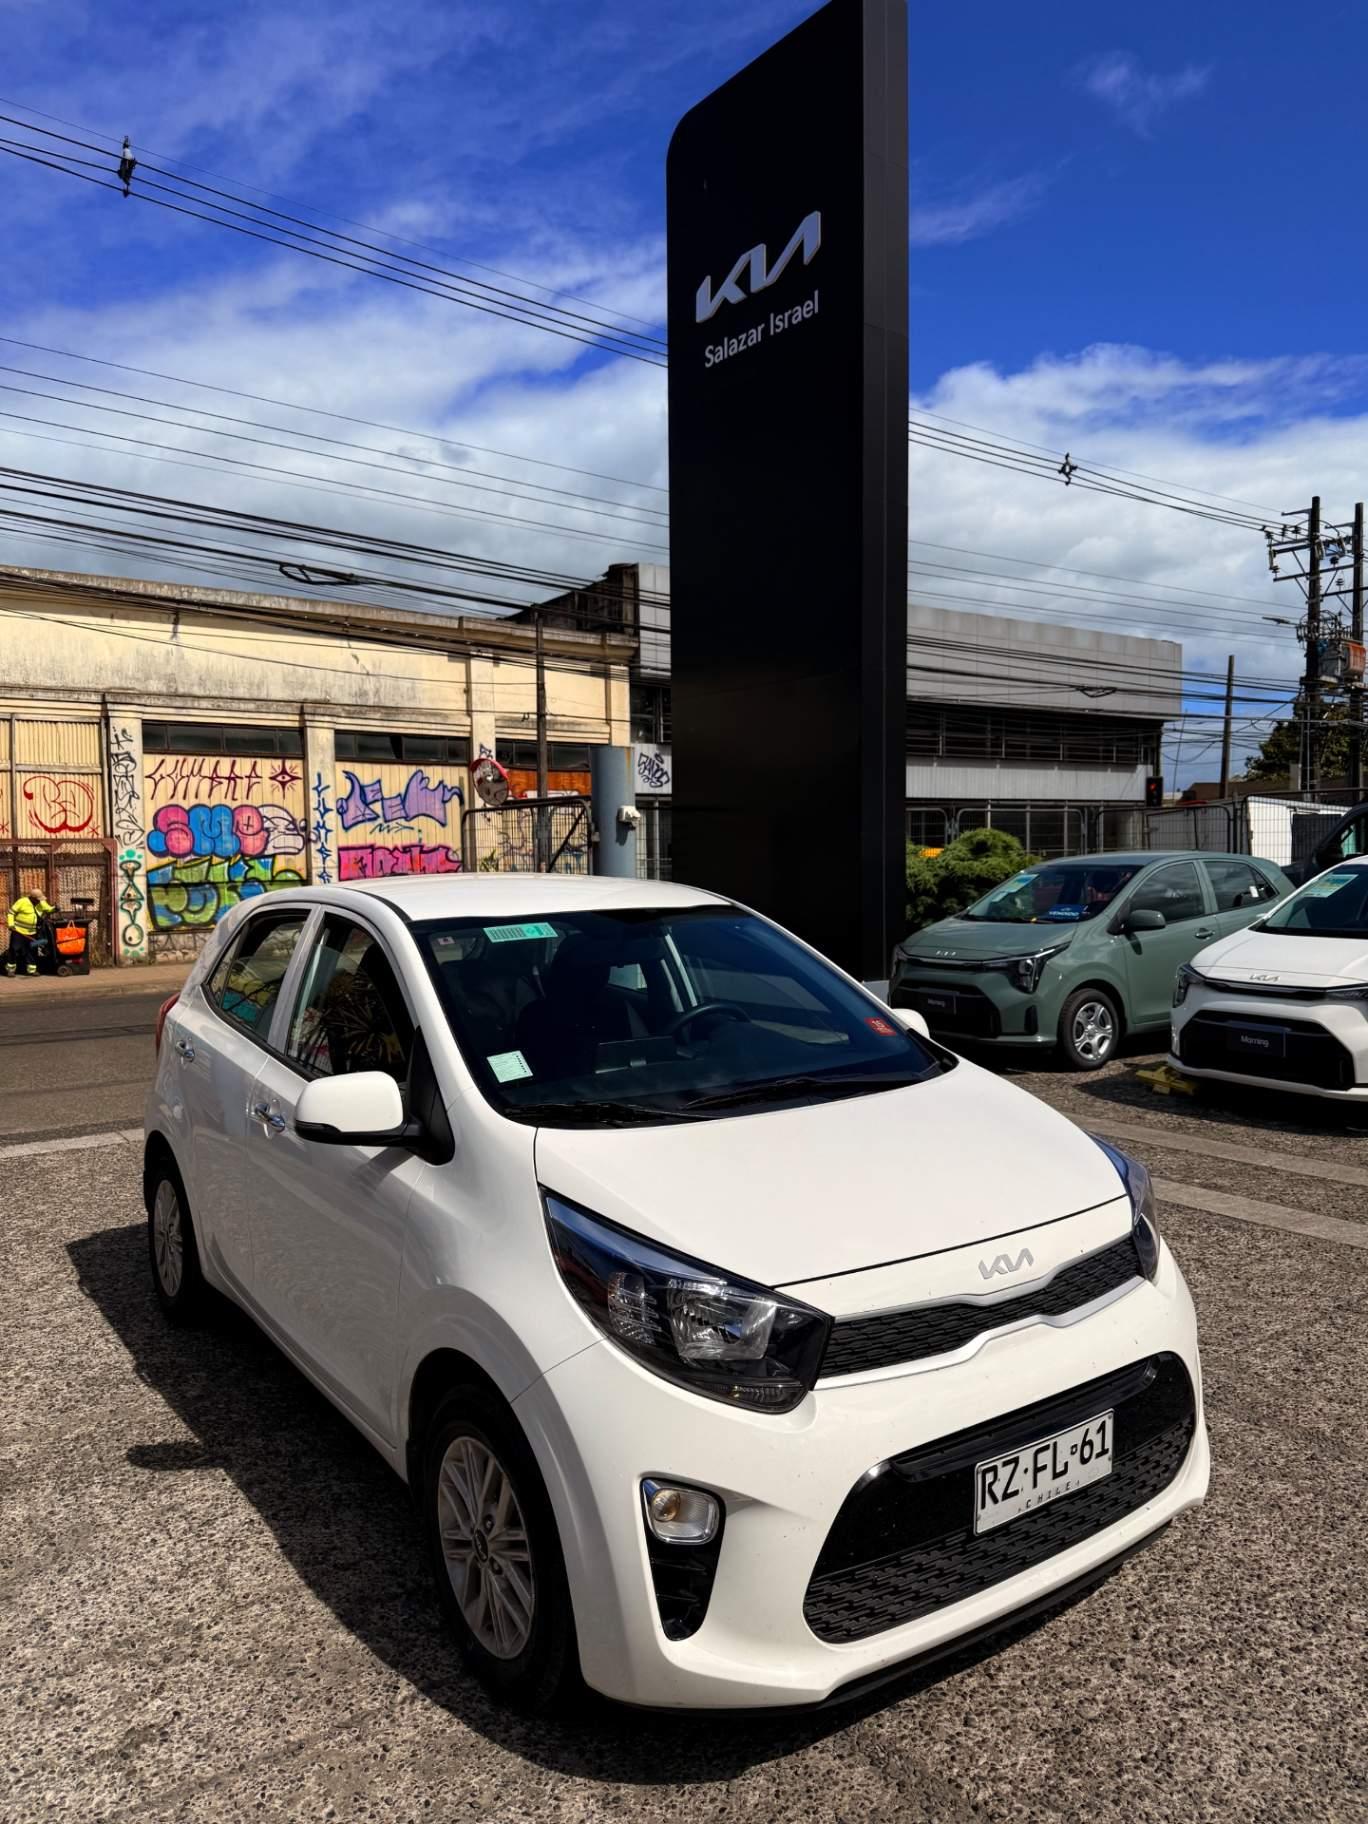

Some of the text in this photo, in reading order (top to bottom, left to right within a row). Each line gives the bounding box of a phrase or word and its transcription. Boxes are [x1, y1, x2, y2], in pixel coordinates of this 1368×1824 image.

[695, 210, 821, 323] KIA
[704, 289, 819, 368] Salazar Israel
[978, 1248, 1034, 1280] KIA
